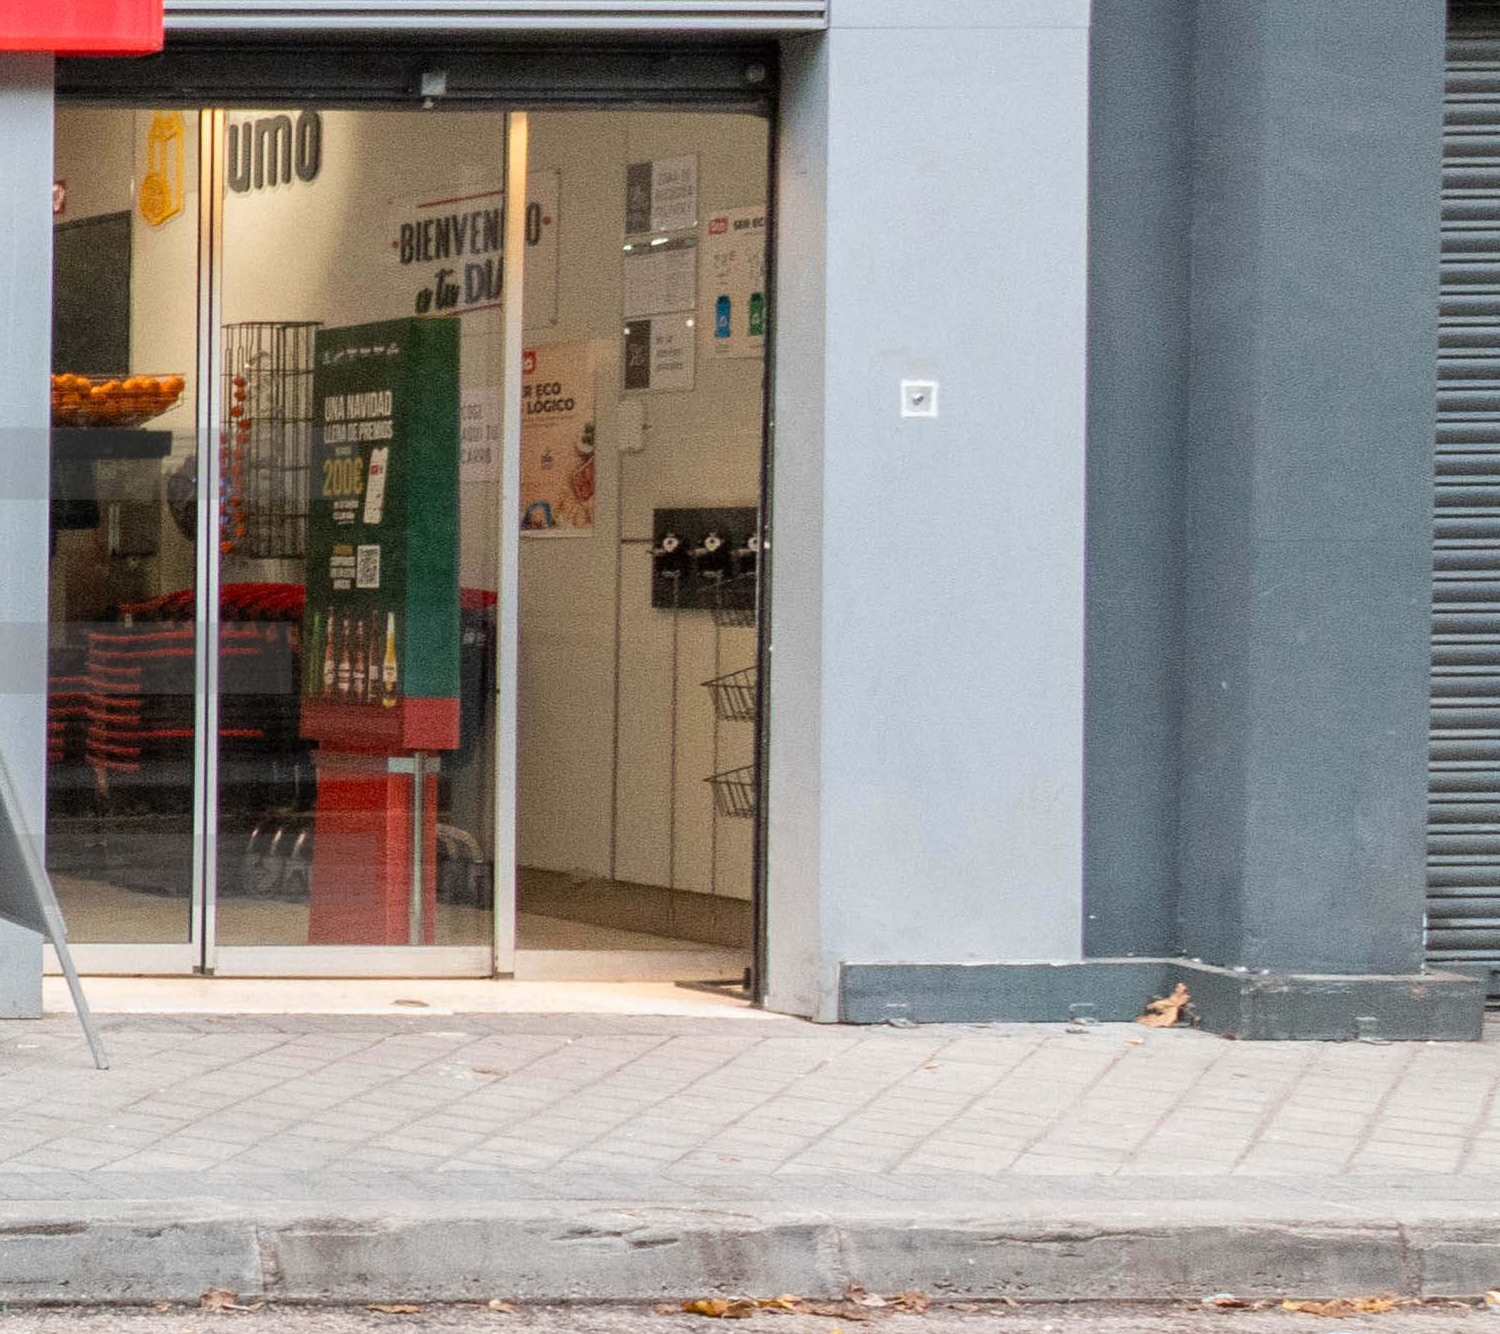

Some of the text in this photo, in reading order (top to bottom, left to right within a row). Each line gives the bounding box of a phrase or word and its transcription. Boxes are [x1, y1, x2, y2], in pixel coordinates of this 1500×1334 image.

[400, 202, 541, 264] BIENVENIO
[347, 390, 393, 420] NAVIDAD
[536, 382, 561, 397] ECO
[323, 457, 364, 498] 200€
